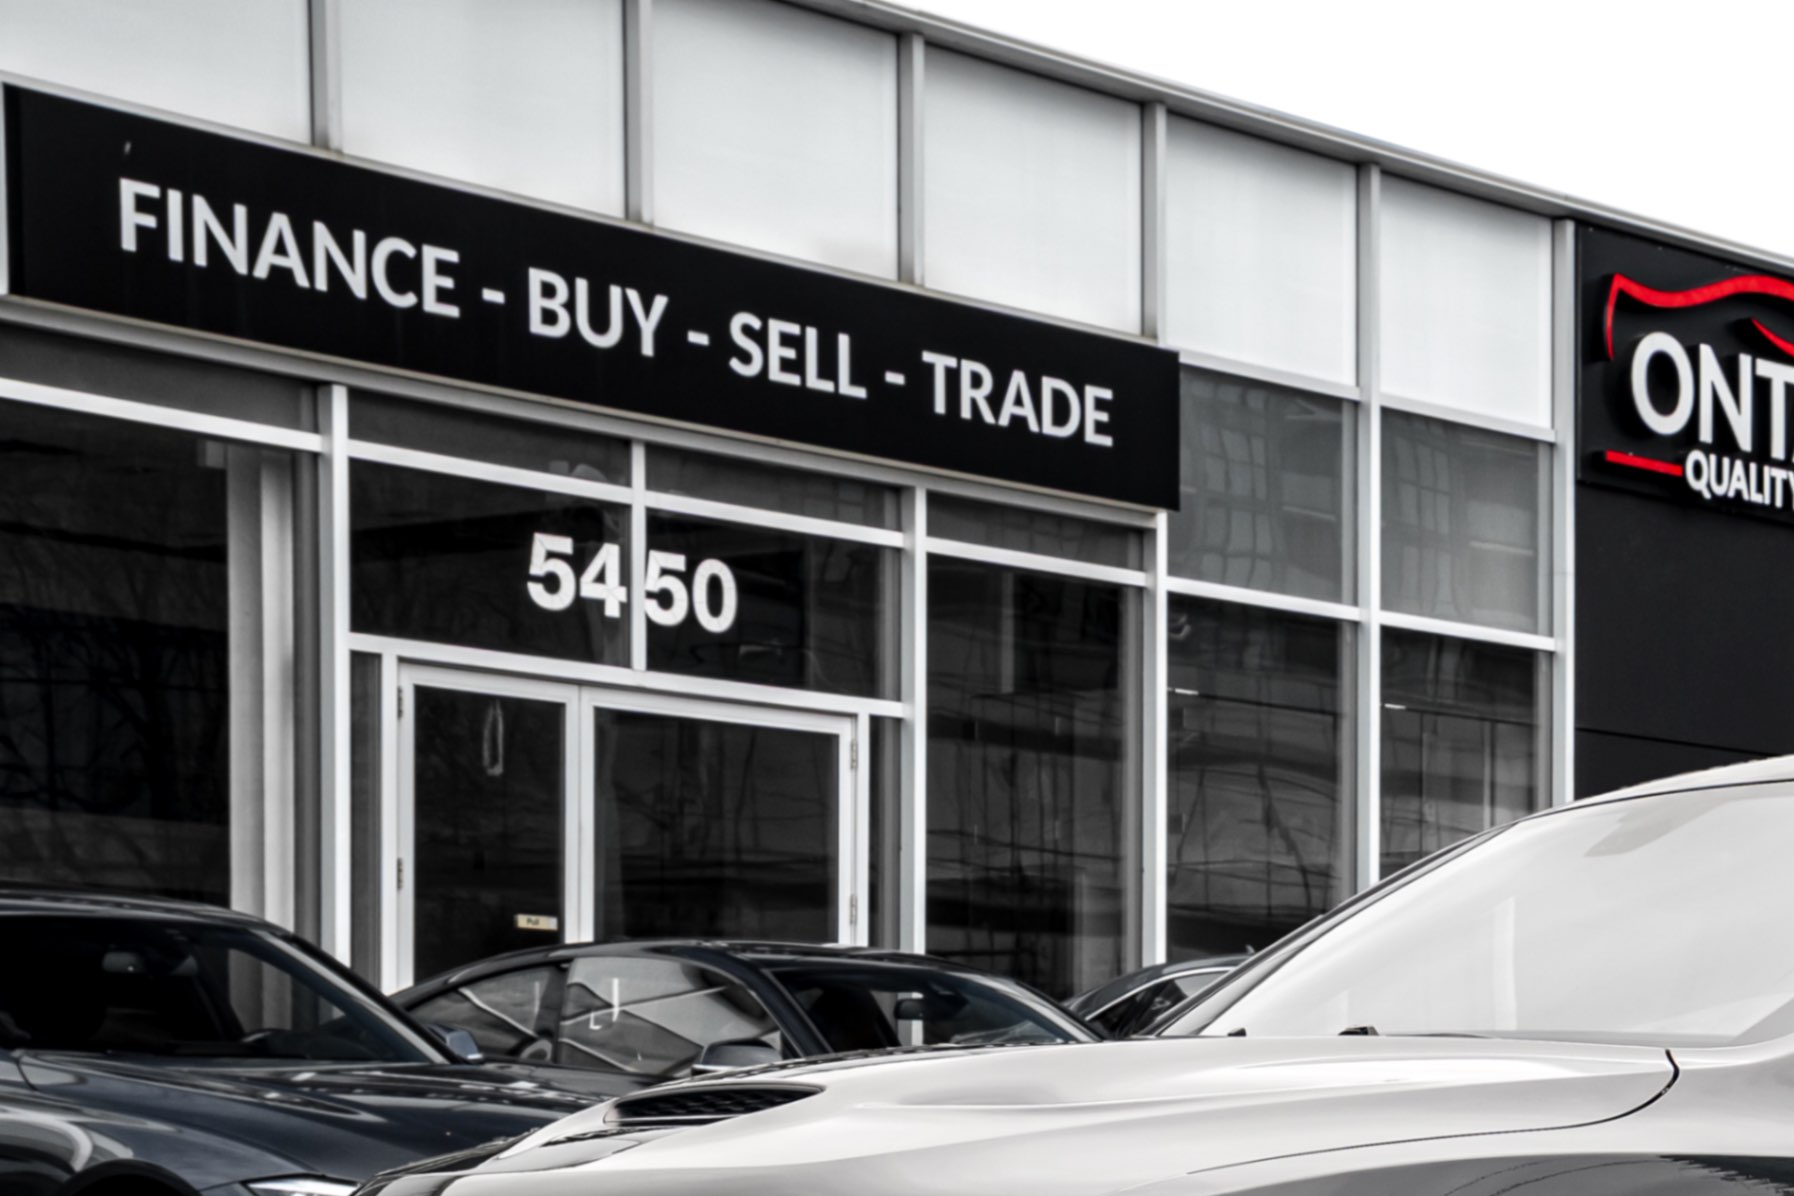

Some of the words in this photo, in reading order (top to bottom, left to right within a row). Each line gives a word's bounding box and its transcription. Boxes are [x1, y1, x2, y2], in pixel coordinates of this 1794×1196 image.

[119, 177, 461, 318] FINANCE
[528, 267, 669, 357] BUY
[728, 312, 867, 399] SELL
[921, 350, 1114, 447] TRADE
[527, 532, 738, 633] 5450
